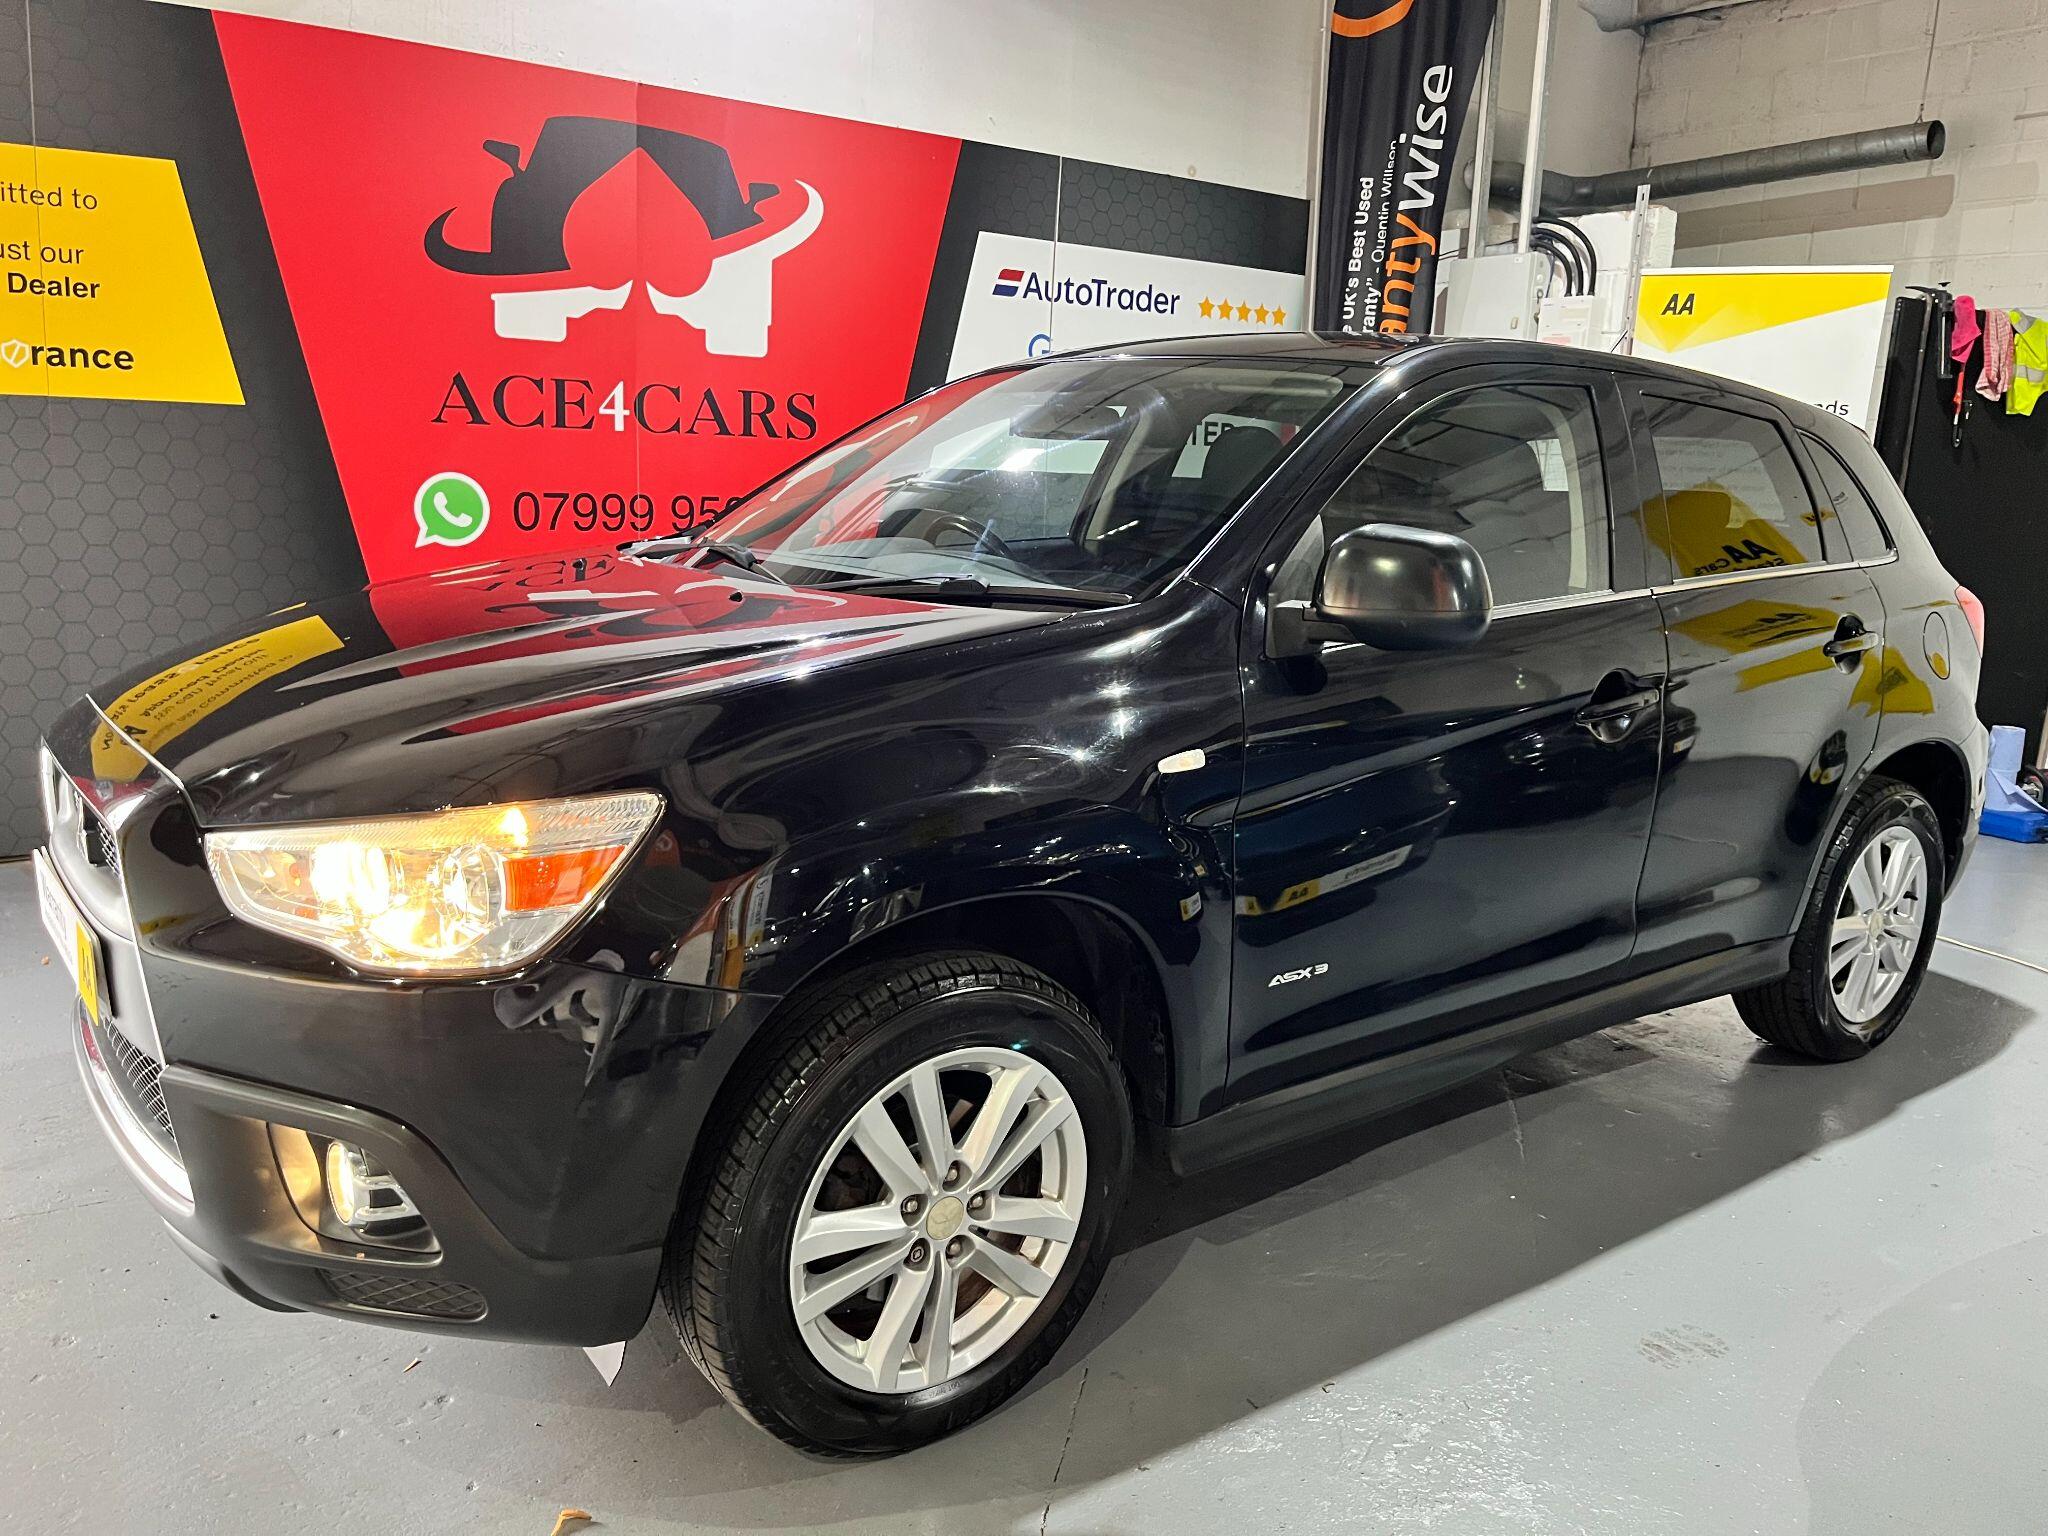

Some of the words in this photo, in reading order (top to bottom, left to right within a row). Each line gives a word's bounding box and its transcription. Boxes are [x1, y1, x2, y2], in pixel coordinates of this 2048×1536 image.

[1380, 140, 1397, 198] Willson
[0, 181, 62, 208] itted
[71, 188, 99, 211] to
[1353, 176, 1374, 225] Used
[1348, 229, 1367, 272] Best
[1371, 201, 1391, 263] Quentin
[40, 245, 84, 265] our
[7, 271, 101, 299] Dealer
[1022, 271, 1181, 316] AutoTrader
[1342, 277, 1359, 320] UK's
[1661, 292, 1696, 316] AA
[430, 371, 818, 441] ACE4CARS
[512, 490, 655, 533] 07999
